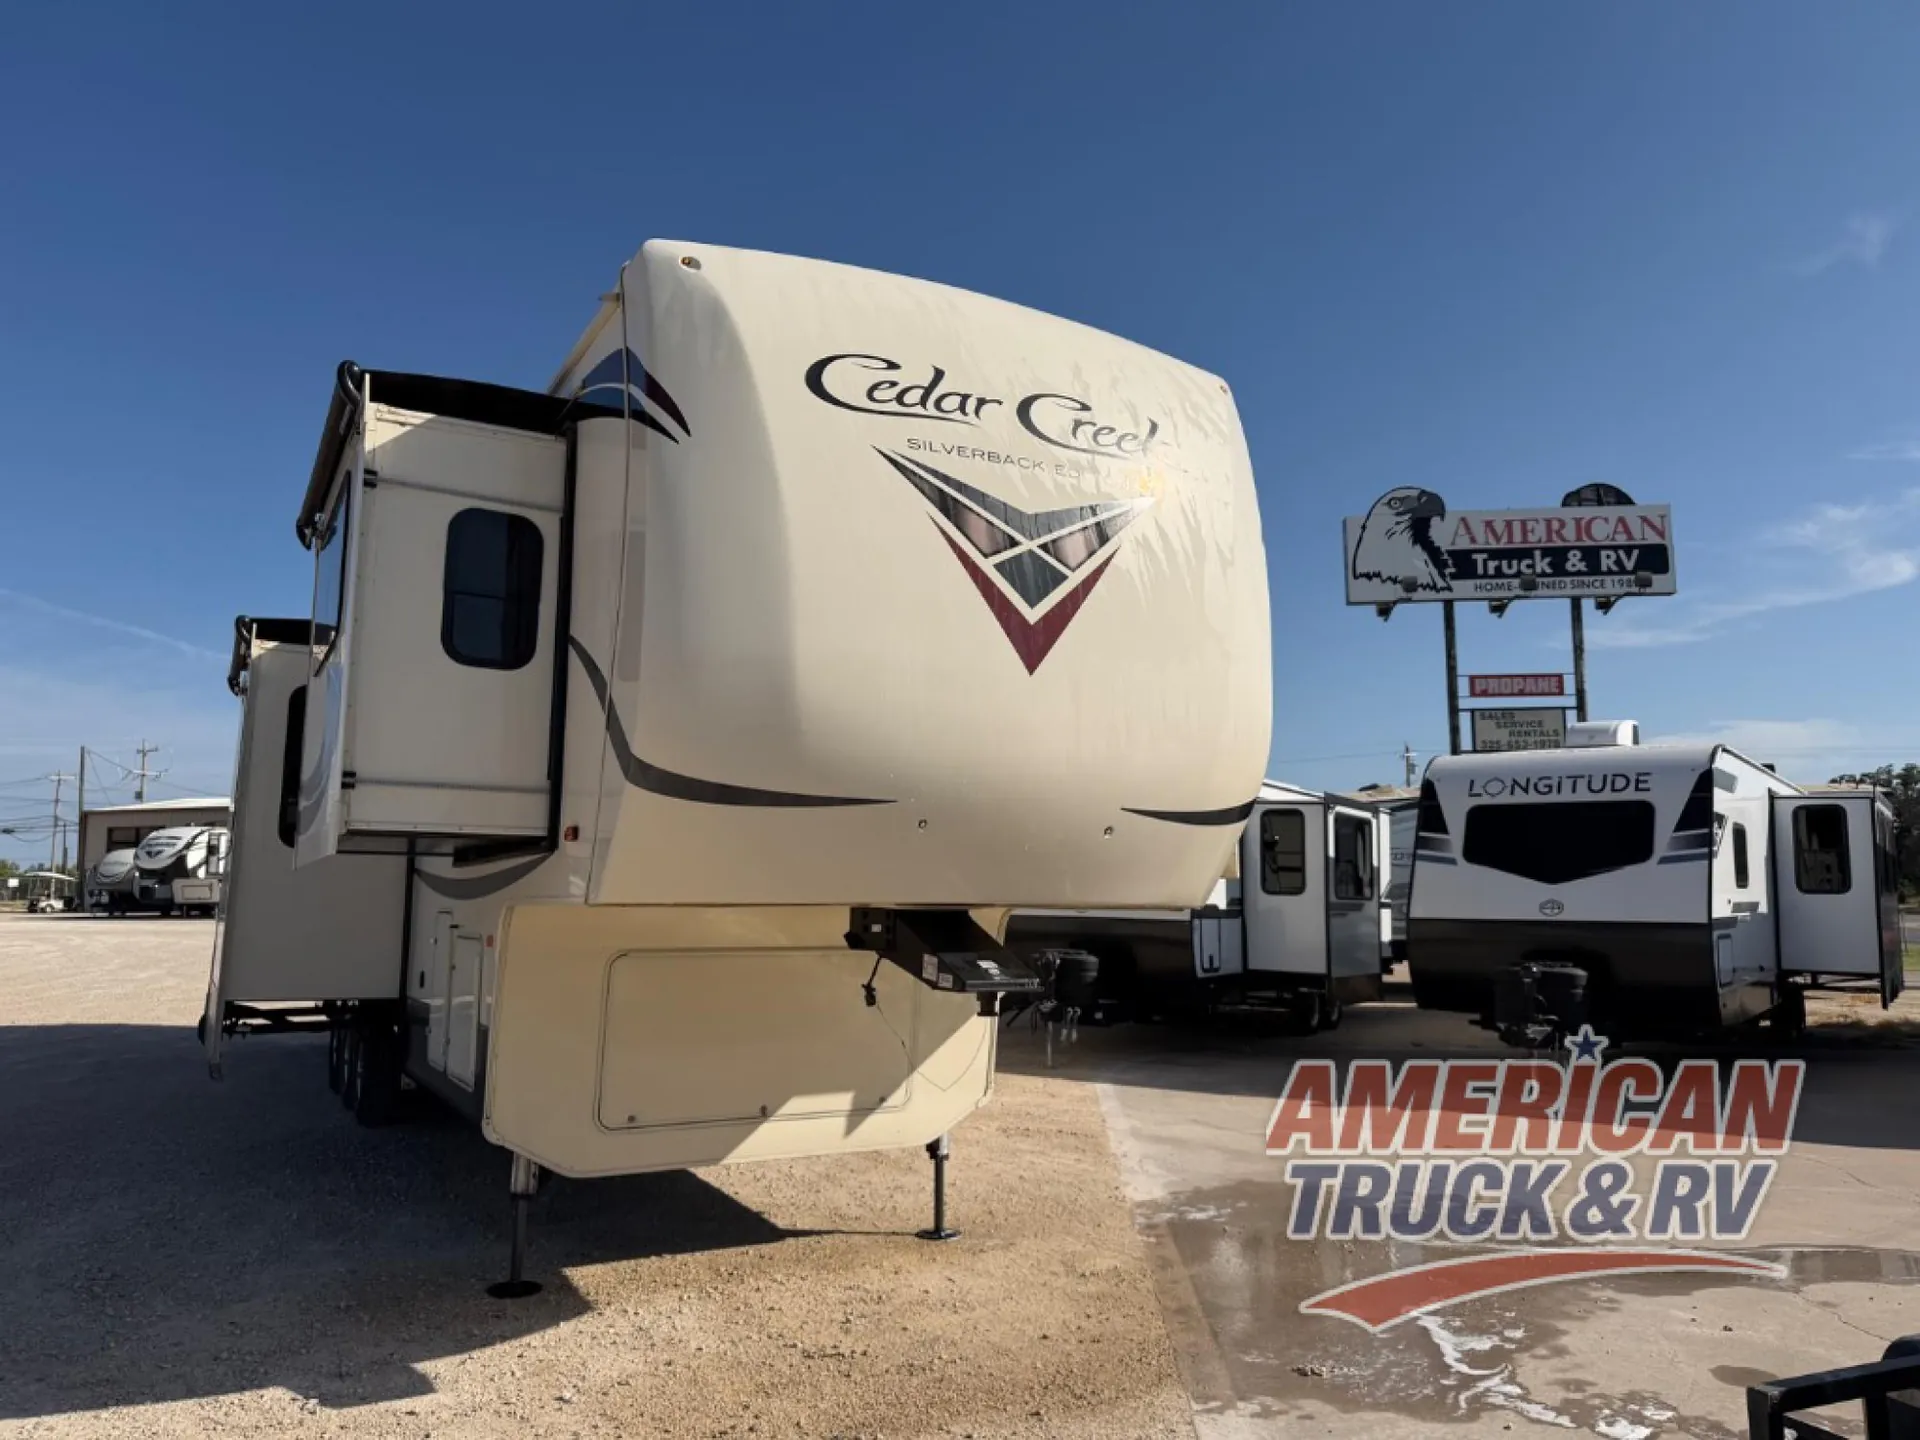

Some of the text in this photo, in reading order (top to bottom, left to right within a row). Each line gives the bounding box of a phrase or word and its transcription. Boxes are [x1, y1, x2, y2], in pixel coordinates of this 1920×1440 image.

[805, 353, 1002, 427] Cedar
[906, 438, 1044, 472] SILVERBACK
[1452, 515, 1667, 545] AMERICAN
[1472, 549, 1640, 575] Truck & RV
[1474, 577, 1637, 592] HOME-NED SINCE 198
[1474, 676, 1560, 695] PROPANE
[1479, 711, 1516, 721] SALES
[1495, 720, 1544, 729] SERVICE
[1508, 728, 1560, 738] RENTALS
[1468, 772, 1653, 798] LONGITUDE
